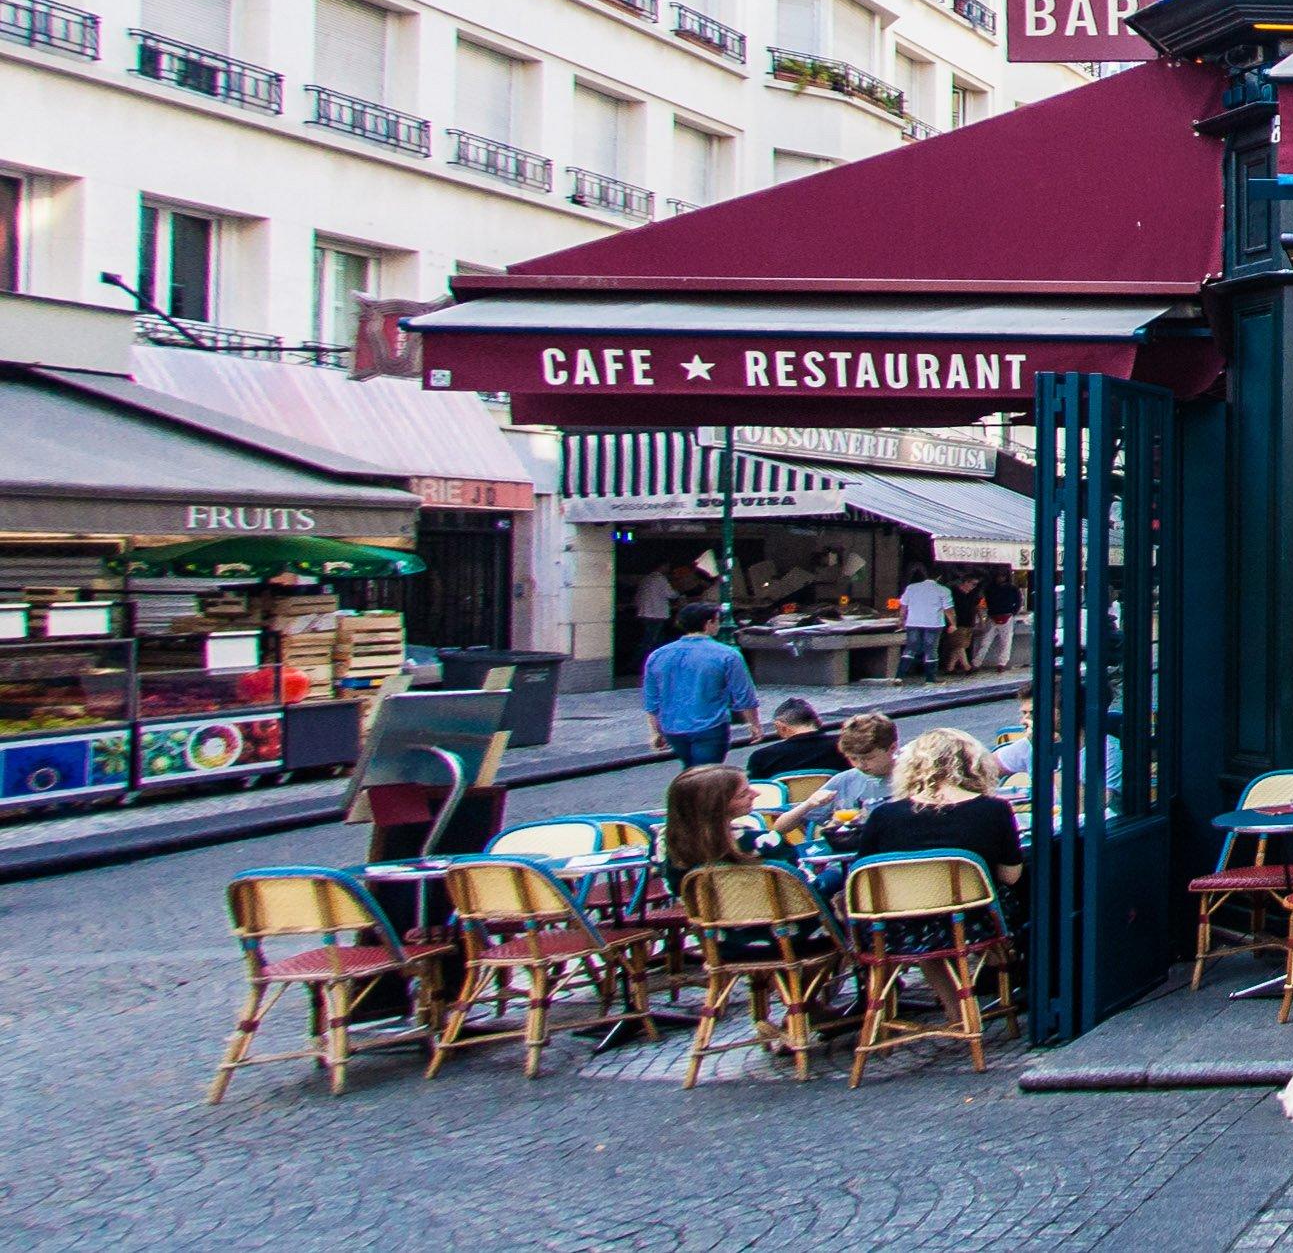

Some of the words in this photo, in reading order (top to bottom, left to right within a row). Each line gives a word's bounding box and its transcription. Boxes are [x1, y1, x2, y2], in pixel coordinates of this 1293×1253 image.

[541, 348, 655, 386] CAFE
[745, 350, 1027, 390] RESTAURANT
[910, 441, 987, 470] SOGUISA
[186, 505, 315, 530] FRUITS
